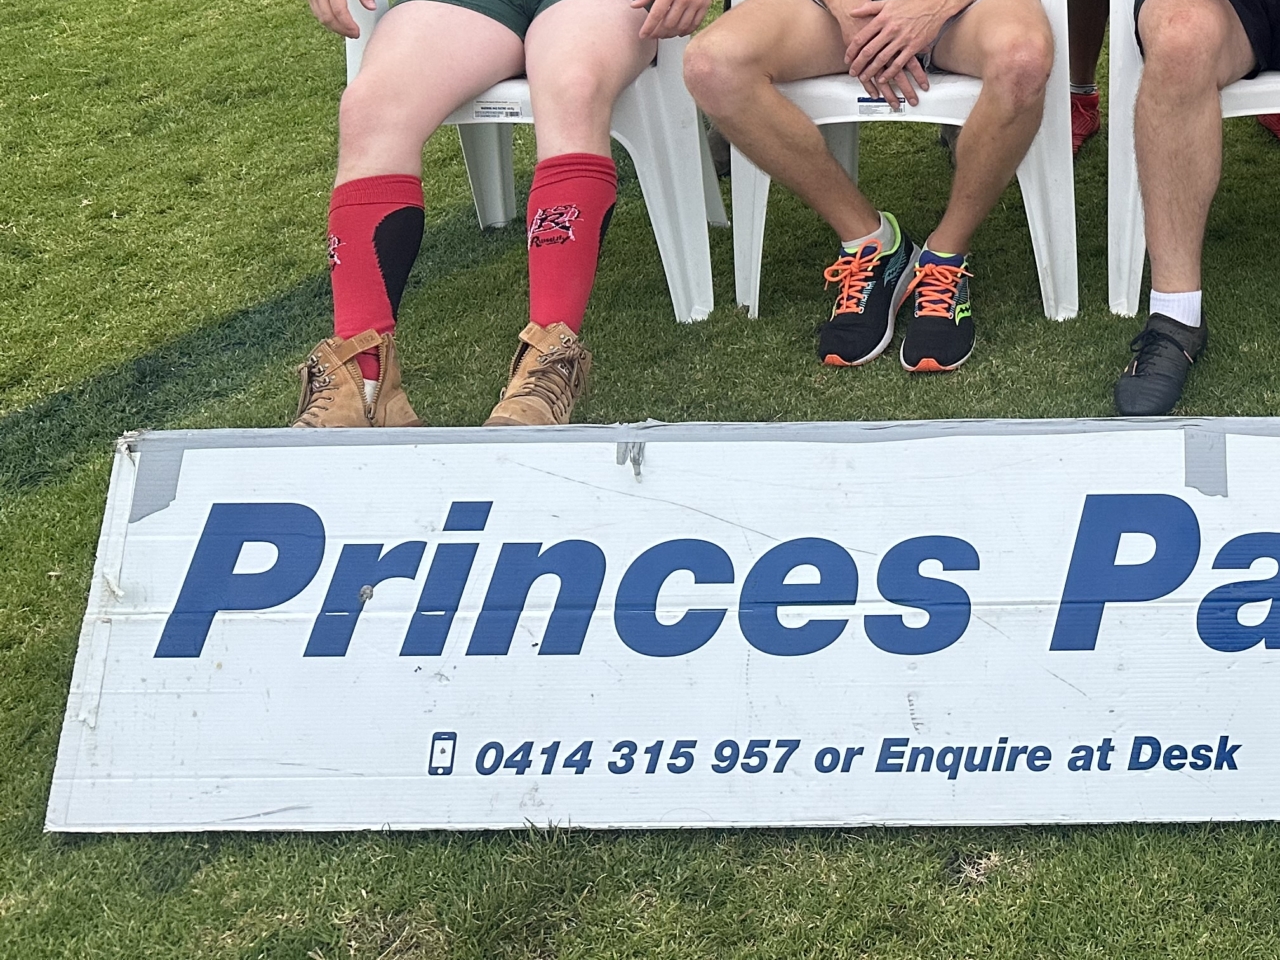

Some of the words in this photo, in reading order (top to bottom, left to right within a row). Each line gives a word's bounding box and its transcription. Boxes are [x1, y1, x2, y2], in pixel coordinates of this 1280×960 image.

[154, 501, 981, 658] Princes
[475, 740, 593, 776] 0414
[608, 740, 698, 775] 315
[711, 739, 801, 774] 957
[814, 746, 865, 773] or
[875, 737, 1052, 780] Enquire
[1067, 738, 1115, 772] at
[1128, 735, 1243, 771] Desk
